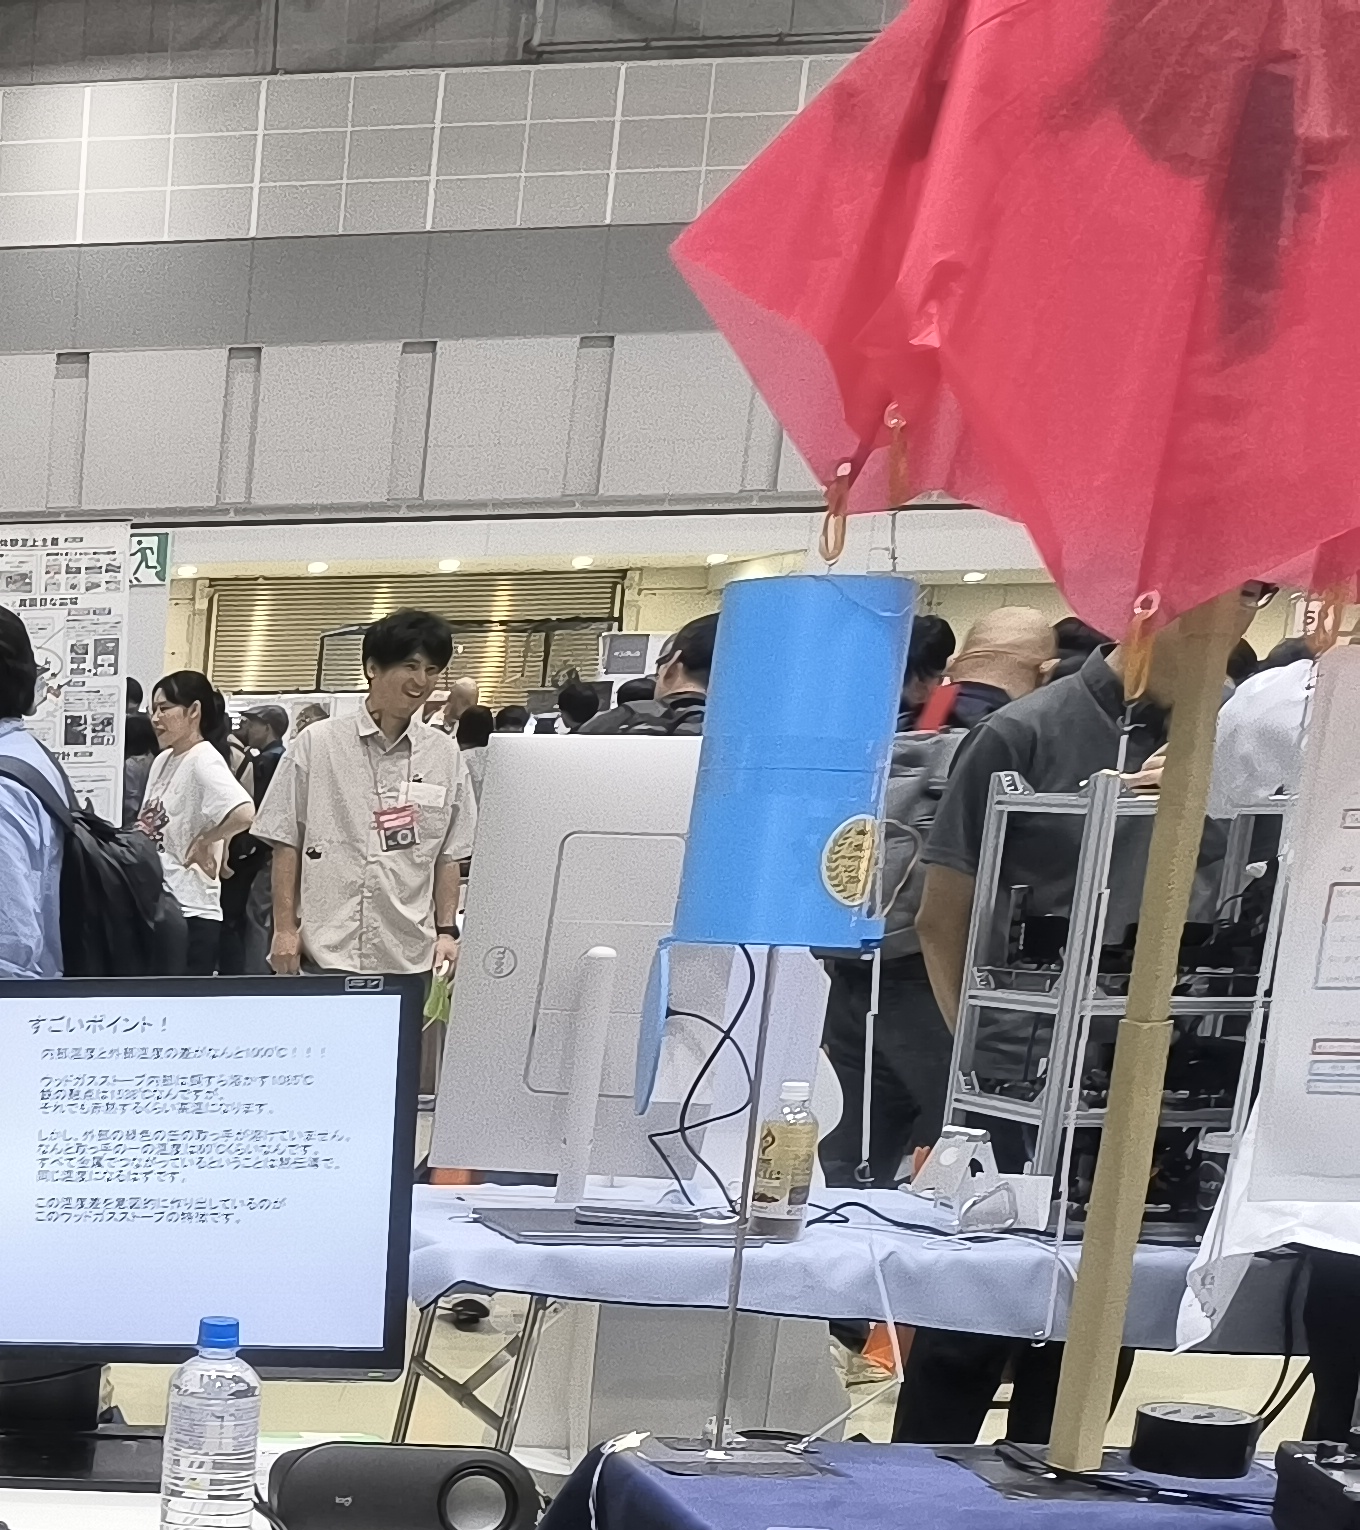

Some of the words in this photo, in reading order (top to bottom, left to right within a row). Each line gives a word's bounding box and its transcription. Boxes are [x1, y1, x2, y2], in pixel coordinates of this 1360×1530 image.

[28, 1014, 168, 1035] すごいポイント！
